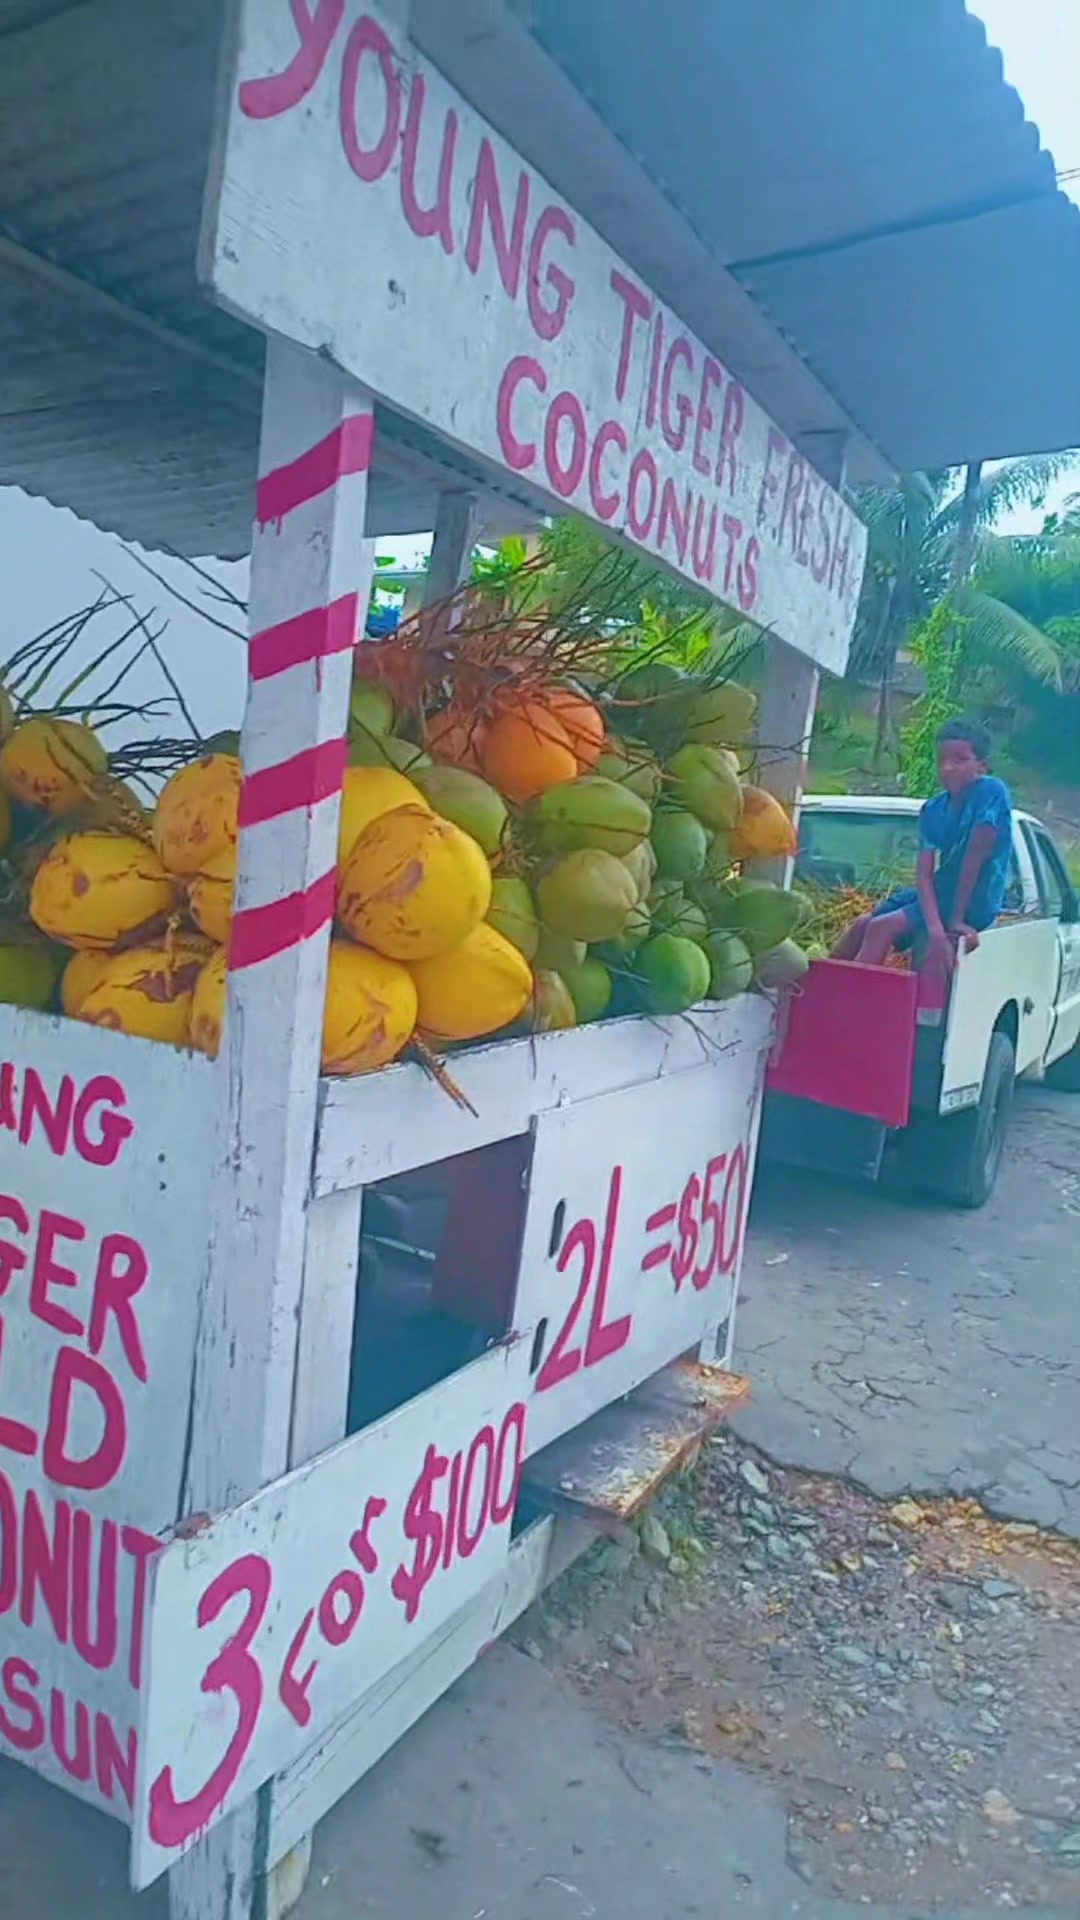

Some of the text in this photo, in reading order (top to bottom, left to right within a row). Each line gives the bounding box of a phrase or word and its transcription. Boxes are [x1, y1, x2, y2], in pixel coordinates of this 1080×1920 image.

[239, 0, 852, 600] YOUNG TIGER FRESH
[497, 355, 761, 611] COCONUTS
[536, 1166, 631, 1392] 2L
[149, 1554, 272, 1848] 3
[391, 1403, 526, 1622] $100
